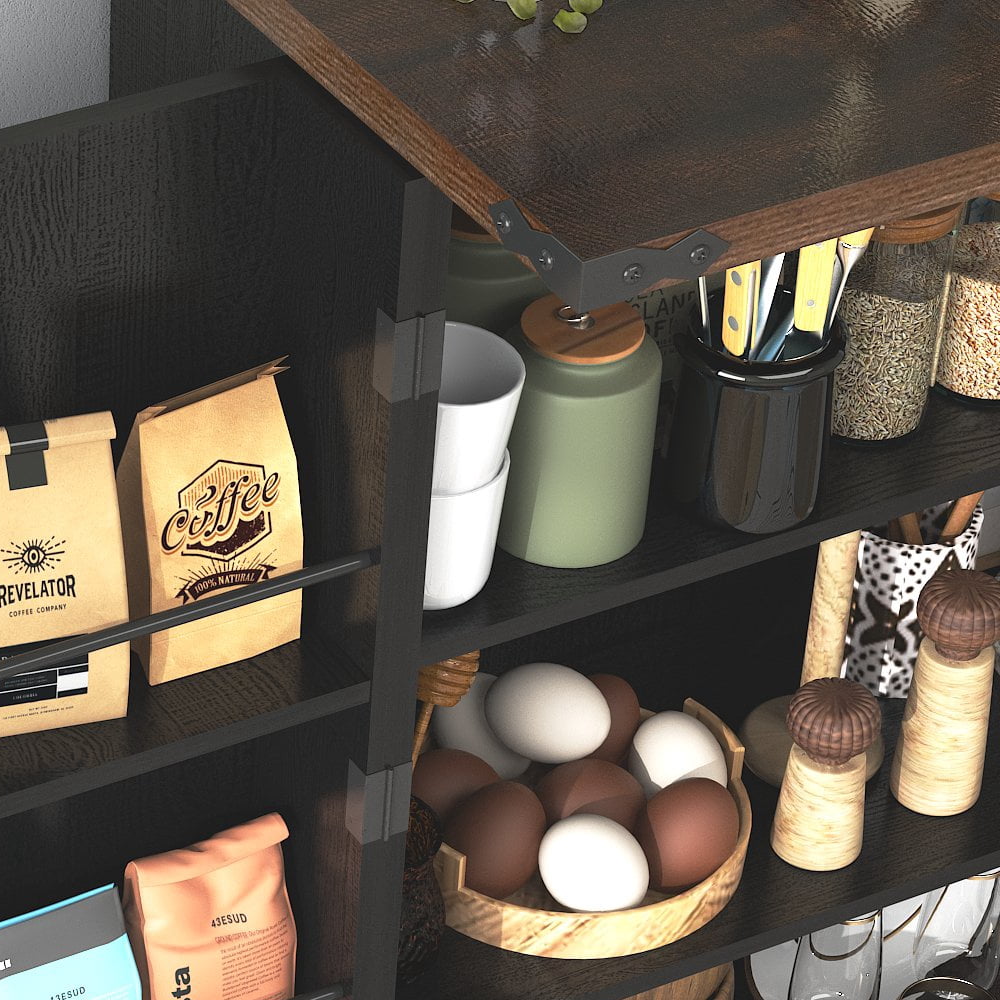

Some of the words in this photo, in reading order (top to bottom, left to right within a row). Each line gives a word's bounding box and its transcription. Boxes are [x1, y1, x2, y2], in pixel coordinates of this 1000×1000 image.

[161, 472, 280, 554] Coffee
[194, 578, 217, 594] 100%
[218, 572, 255, 584] NATURAL
[8, 608, 33, 617] COFFEE
[36, 603, 67, 614] COMPANY
[211, 913, 247, 928] 43ESUD
